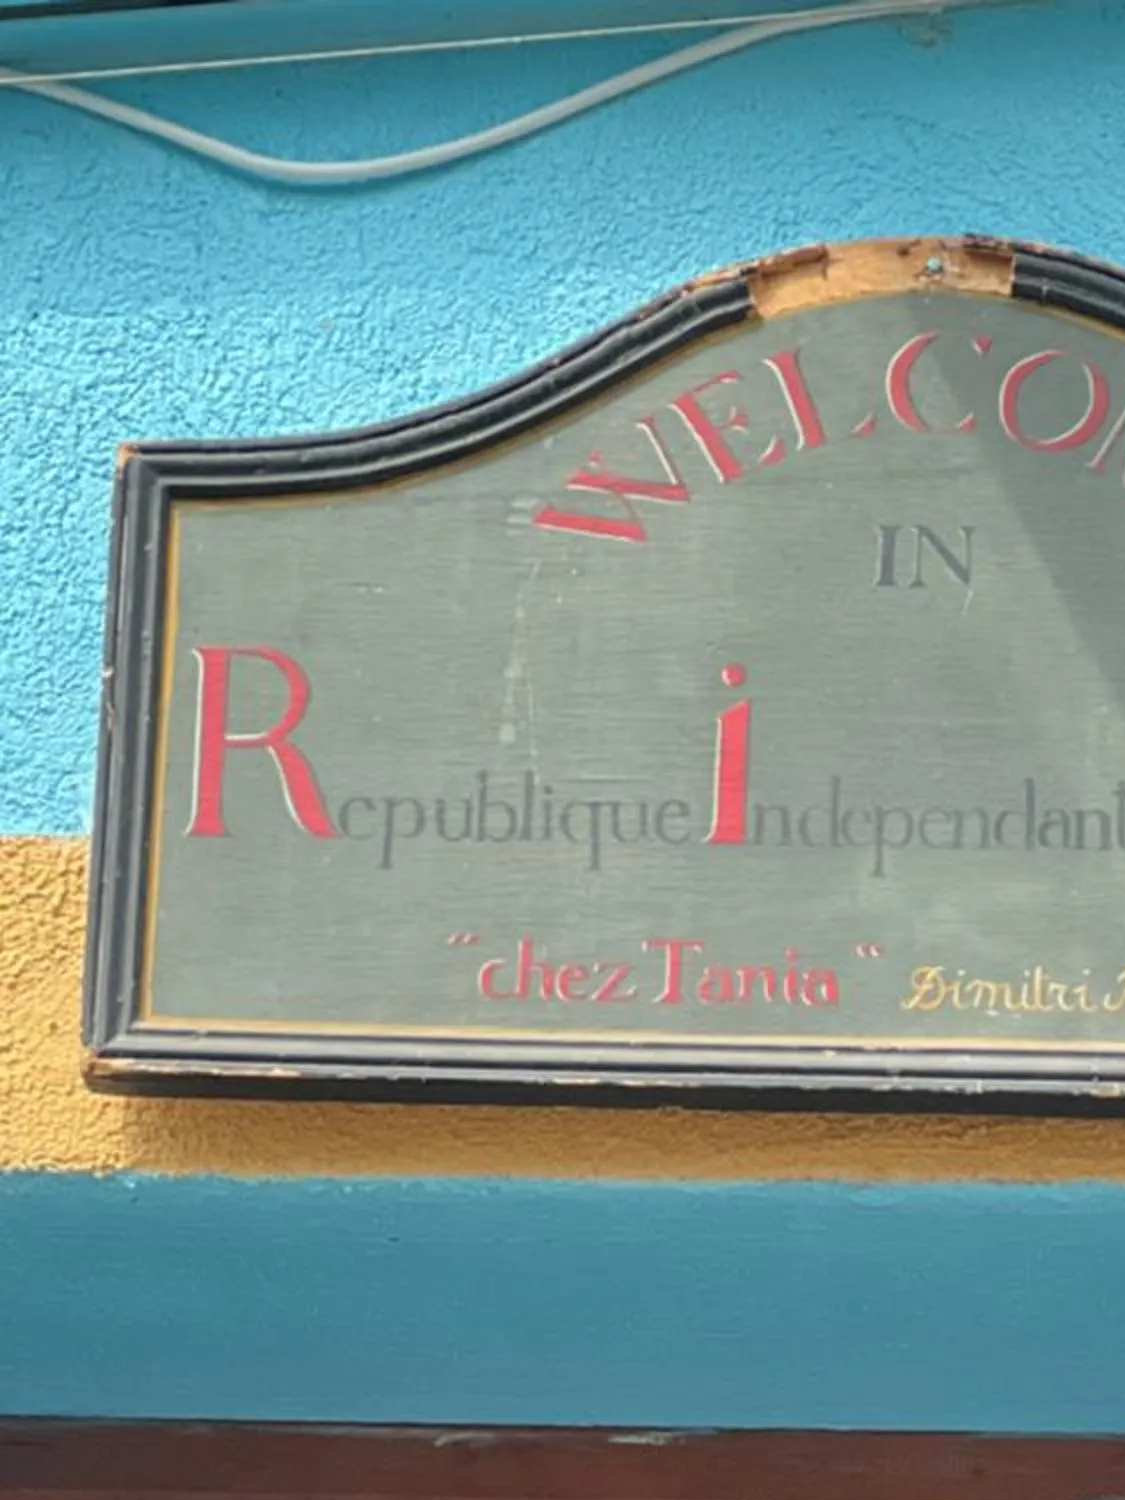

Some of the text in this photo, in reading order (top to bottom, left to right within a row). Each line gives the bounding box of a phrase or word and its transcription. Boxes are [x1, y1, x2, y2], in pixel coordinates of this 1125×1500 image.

[872, 523, 977, 588] IN
[184, 645, 691, 878] Republique
[901, 965, 1099, 1017] Dimitri
